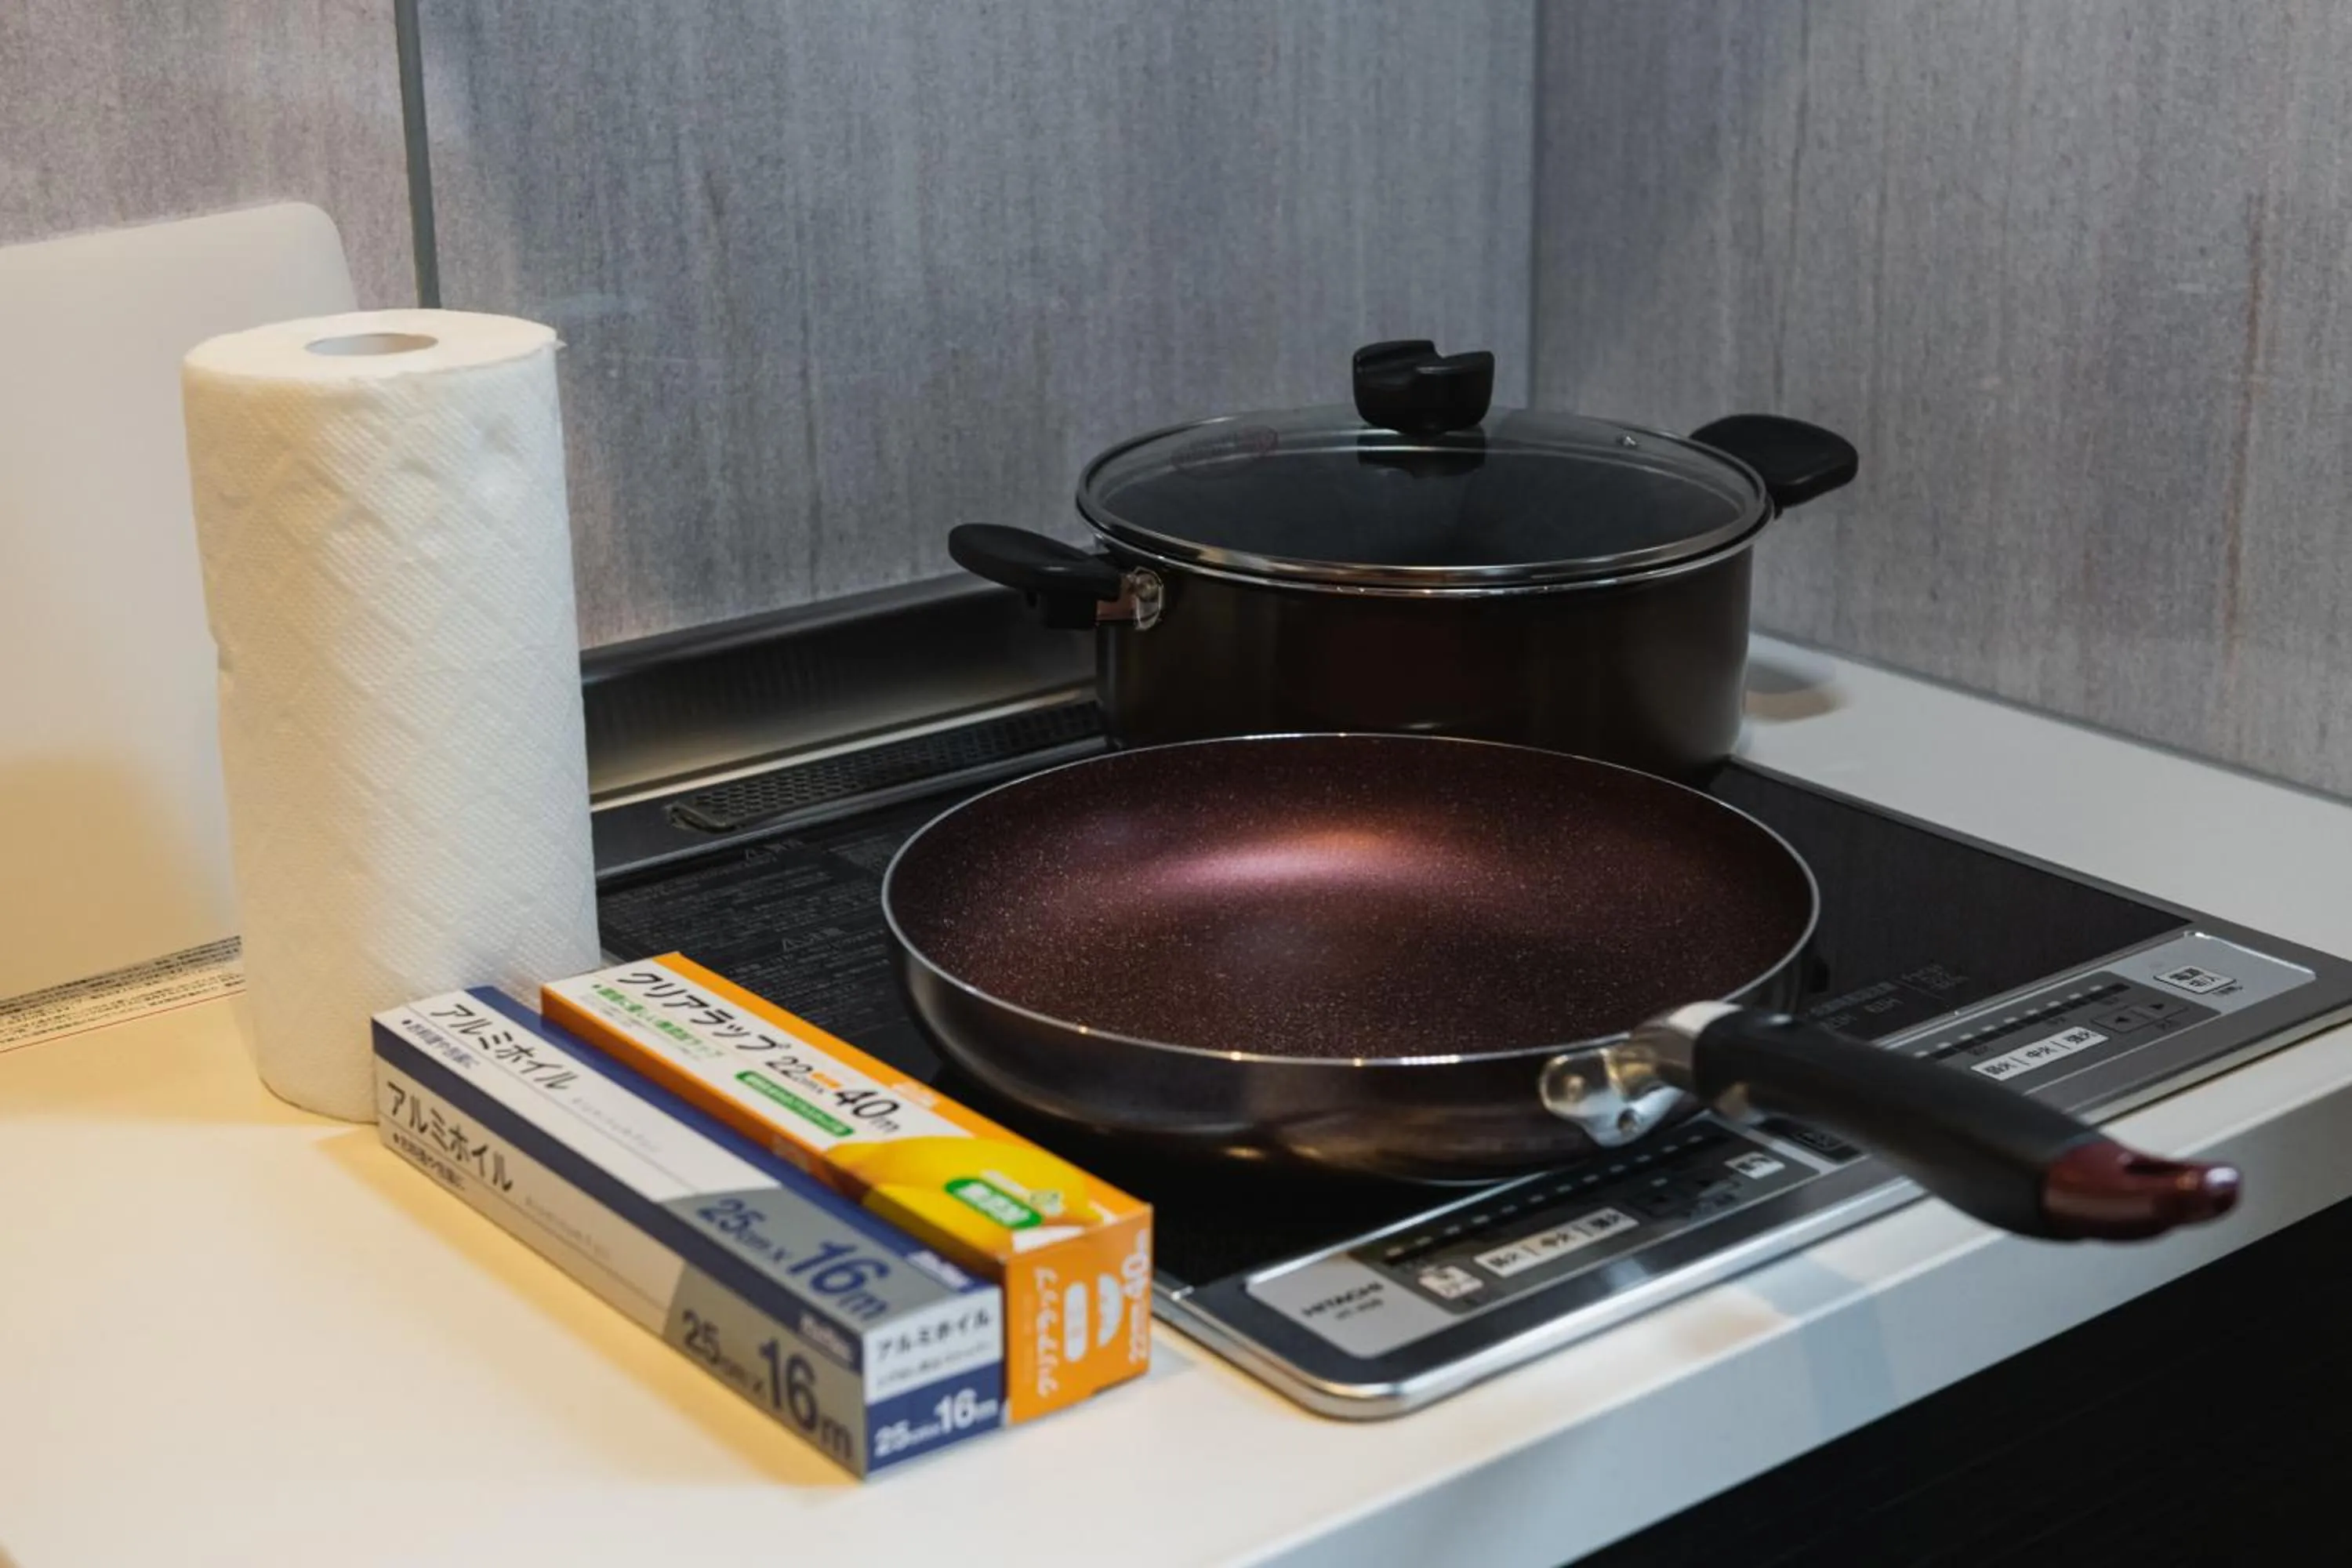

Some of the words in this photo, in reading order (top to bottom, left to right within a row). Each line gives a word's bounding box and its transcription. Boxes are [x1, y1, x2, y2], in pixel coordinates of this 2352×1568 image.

[430, 1004, 579, 1091] アルミホイル
[616, 971, 790, 1052] クリアラップ
[388, 1081, 514, 1192] アルミホイル
[1301, 1280, 1385, 1317] HITACHI
